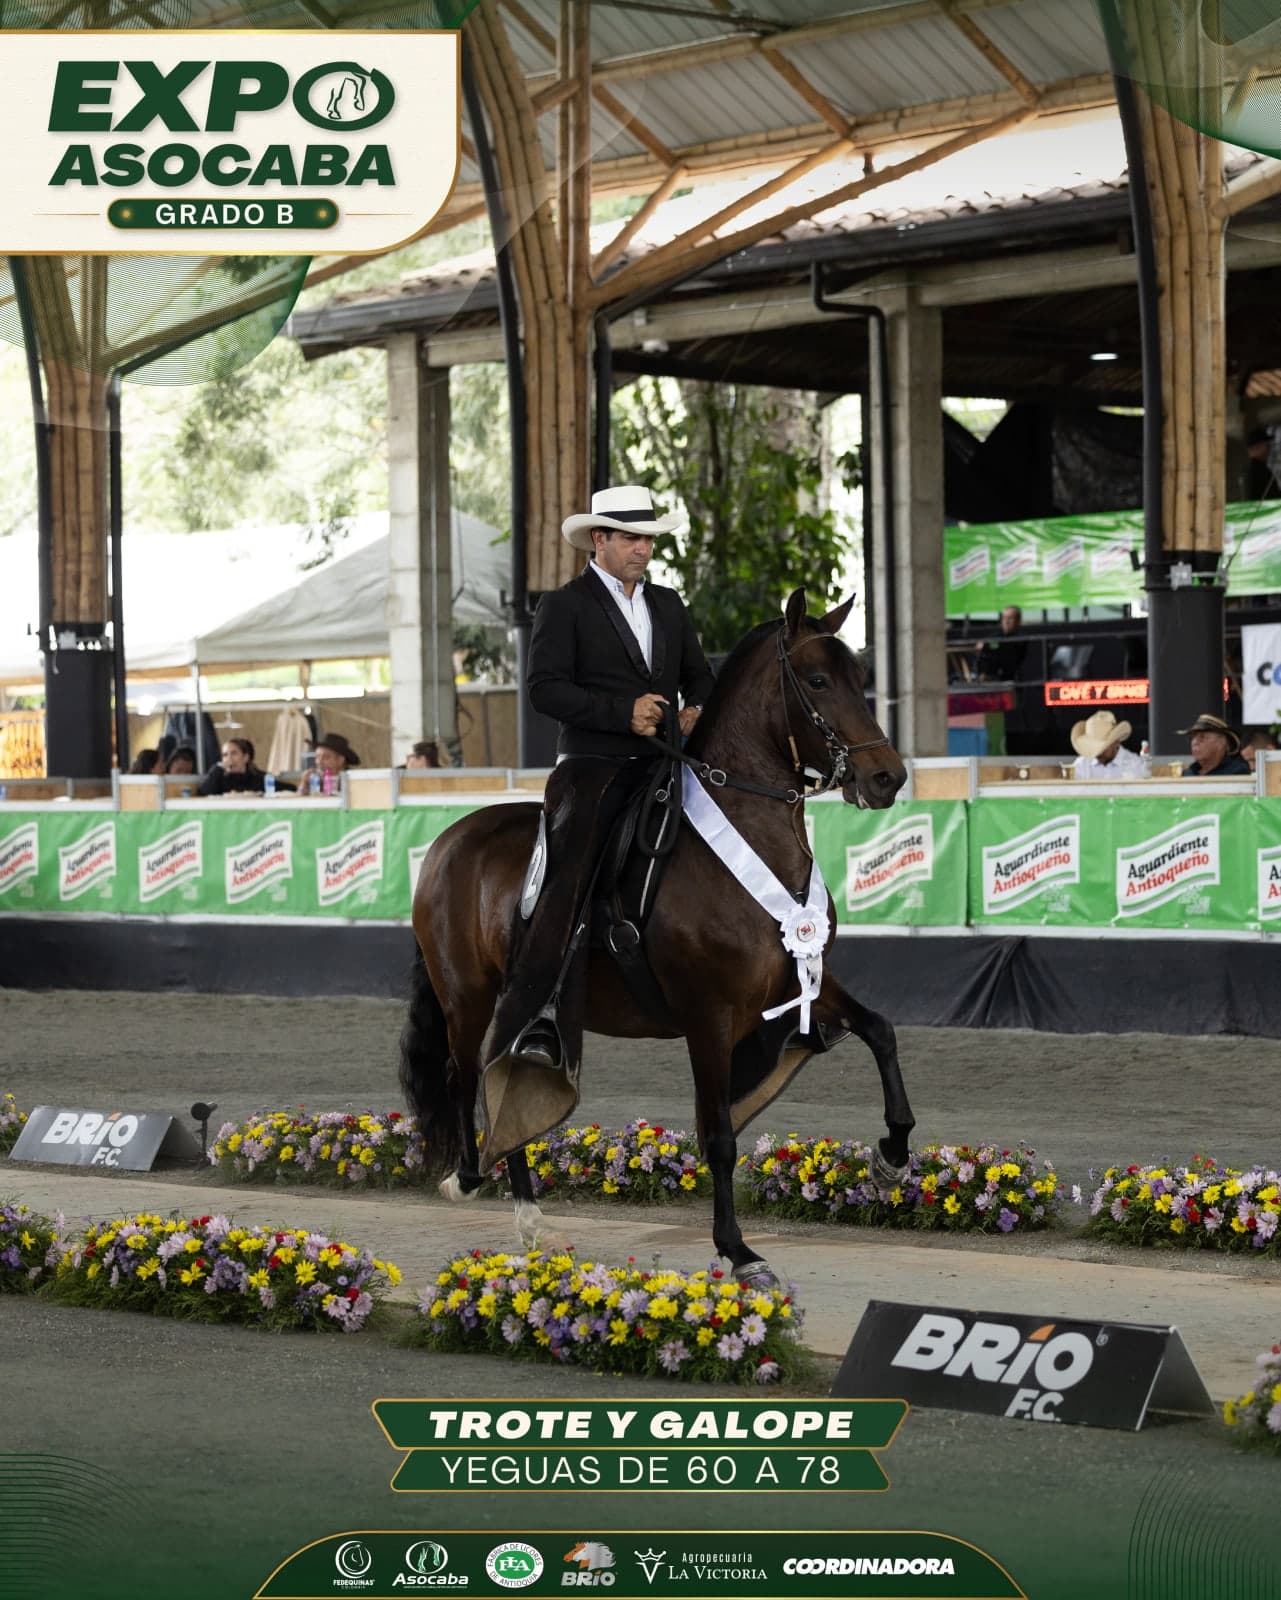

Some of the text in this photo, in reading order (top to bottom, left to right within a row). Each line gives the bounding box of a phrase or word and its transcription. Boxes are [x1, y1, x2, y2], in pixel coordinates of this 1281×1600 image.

[993, 850, 1071, 895] Antioqueño
[994, 836, 1070, 878] Aguardiente
[1126, 851, 1209, 897] Antioqueño
[1127, 836, 1209, 880] Aguardiente
[91, 1147, 122, 1166] F.C.
[1004, 1388, 1064, 1422] F.C.
